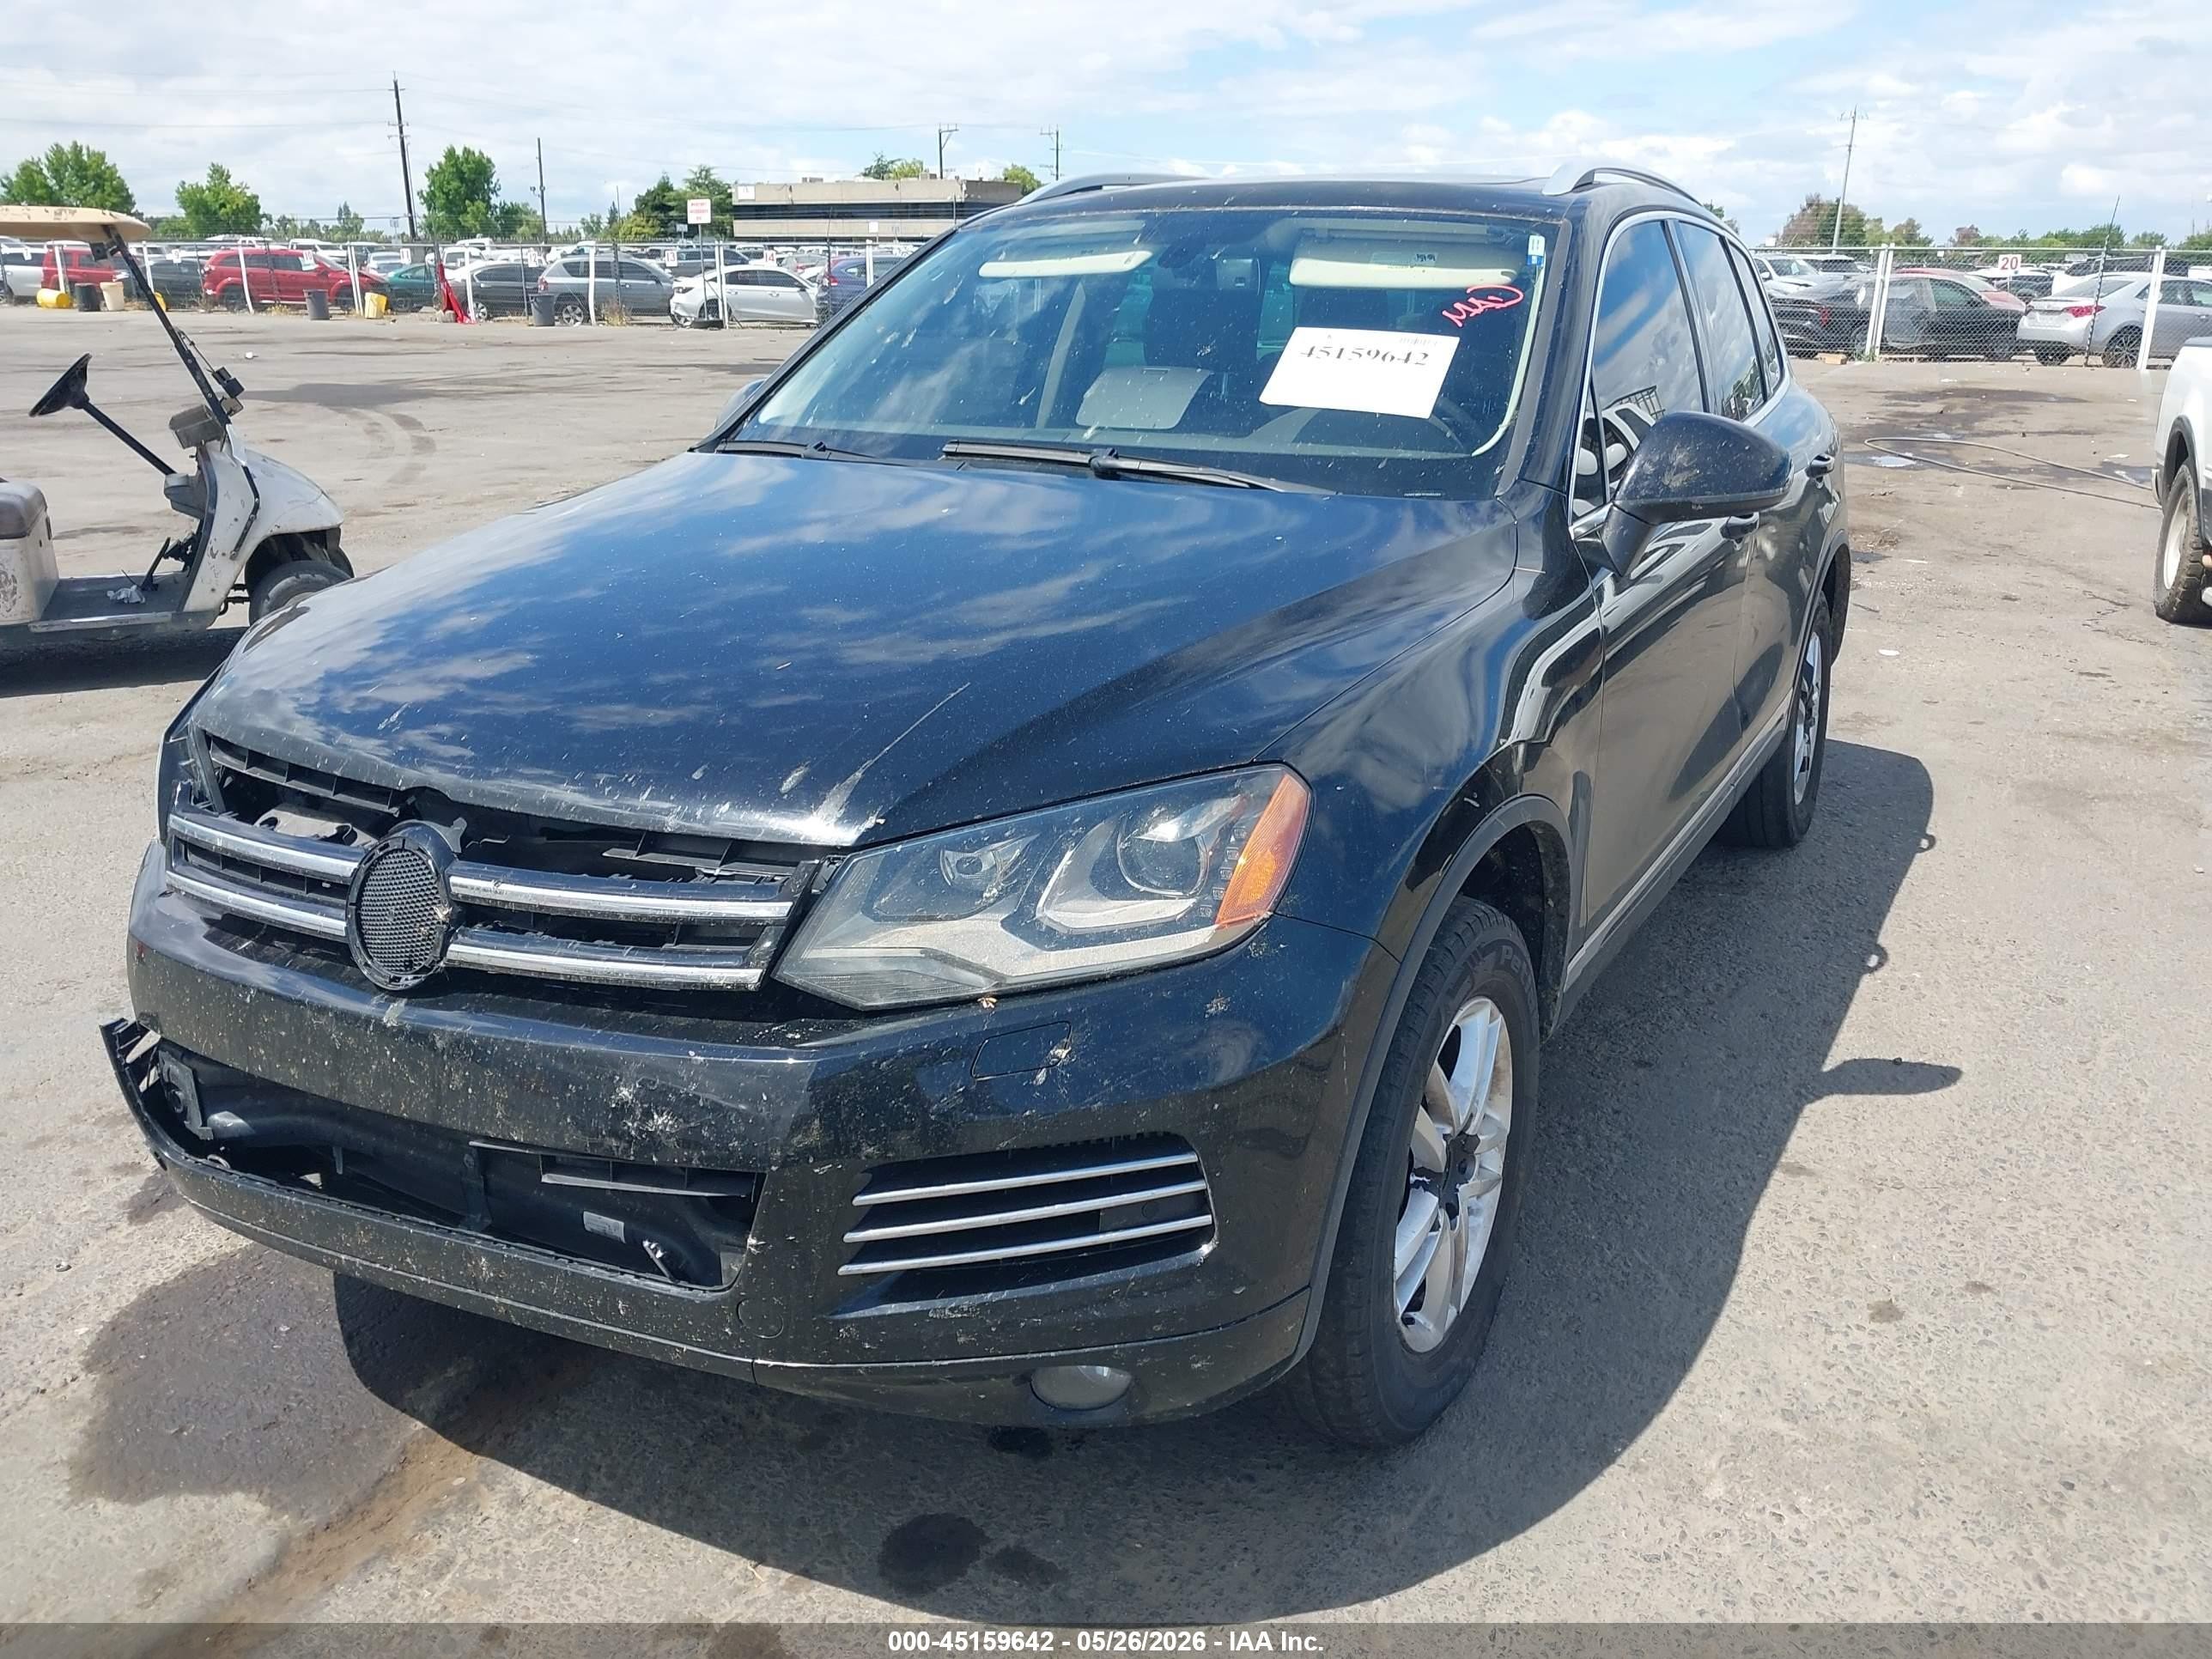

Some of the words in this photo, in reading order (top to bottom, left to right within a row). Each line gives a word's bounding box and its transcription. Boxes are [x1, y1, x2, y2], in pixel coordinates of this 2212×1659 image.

[667, 252, 676, 262] 13
[765, 252, 775, 262] 14
[2000, 256, 2019, 270] 20
[1298, 344, 1430, 366] 45159642
